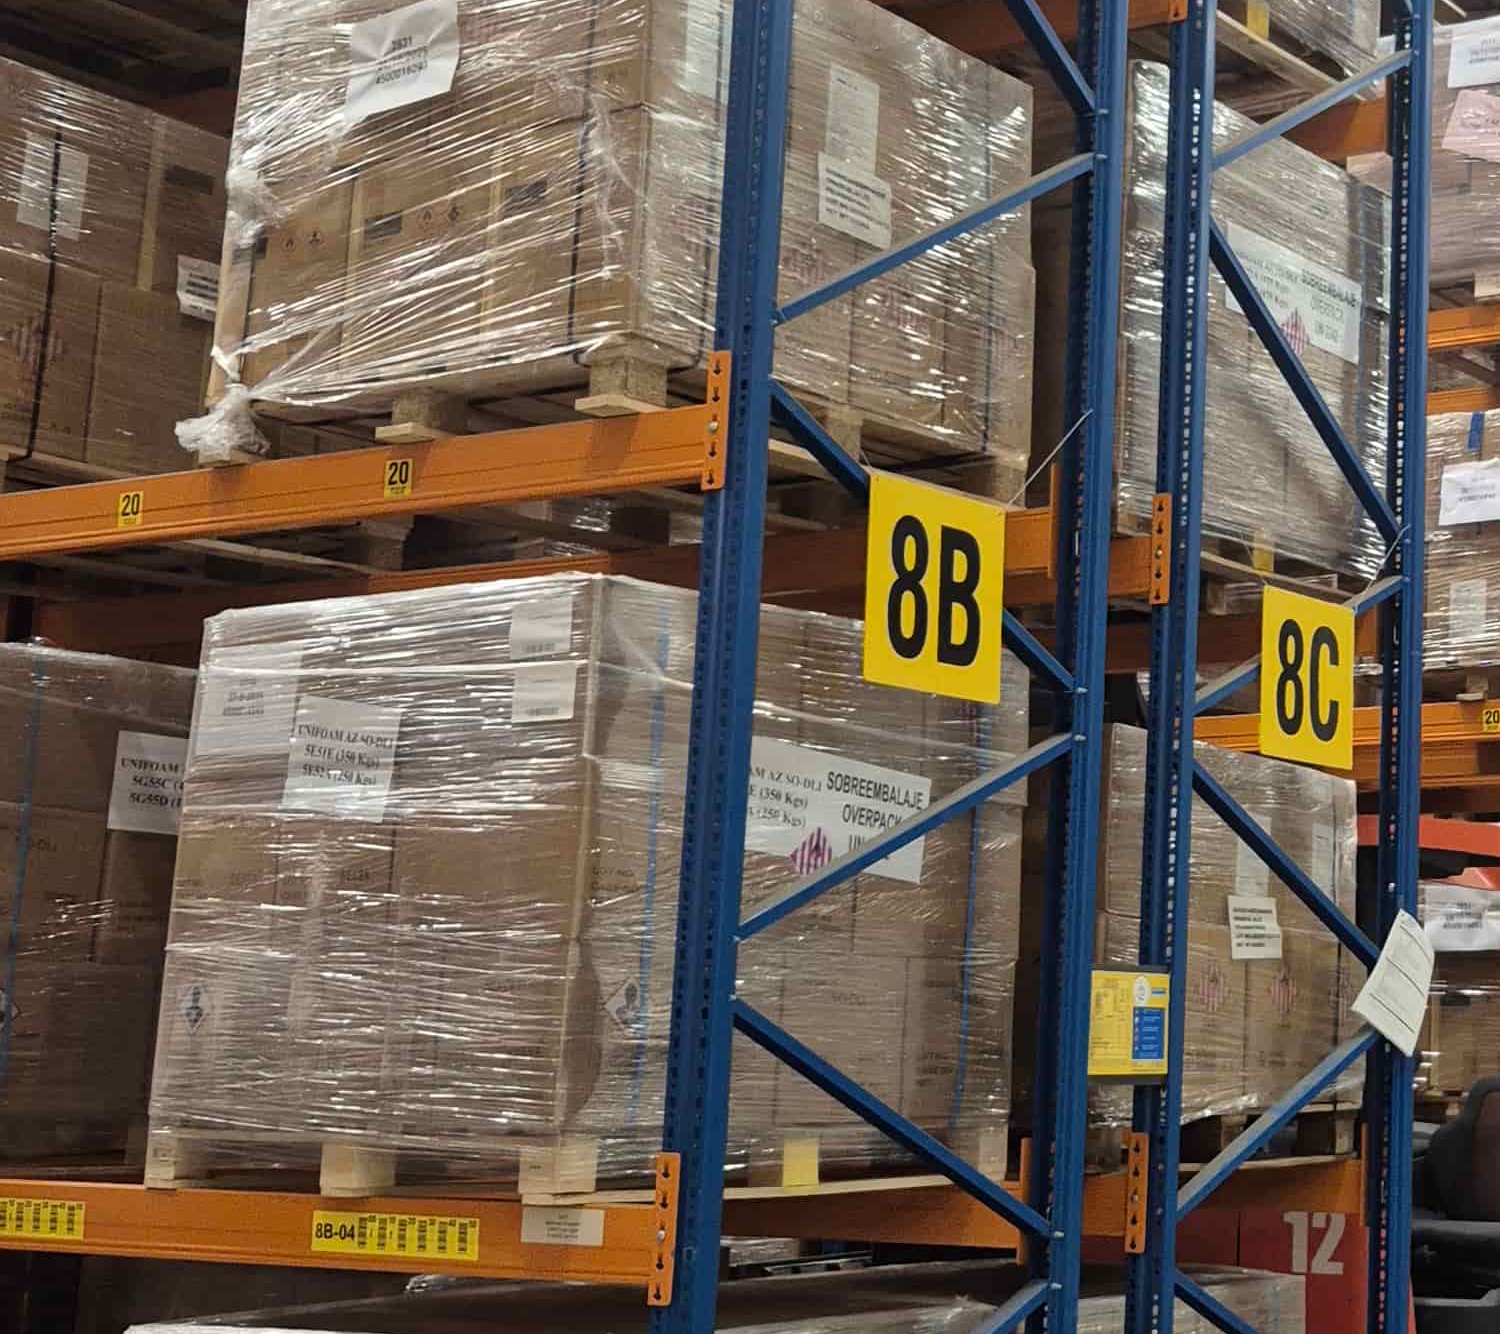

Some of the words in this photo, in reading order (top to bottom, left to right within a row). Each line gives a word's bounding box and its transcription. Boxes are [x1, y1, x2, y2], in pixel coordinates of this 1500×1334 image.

[387, 460, 410, 485] 20
[121, 494, 141, 517] 20
[887, 514, 982, 668] 8B
[1276, 618, 1341, 742] 8C
[1485, 710, 1500, 725] 20
[121, 757, 179, 773] UNIFOAM
[826, 770, 924, 810] SOBREEMBALAJE
[842, 804, 903, 829] OVERPACK
[315, 1222, 356, 1241] 8B-04
[1283, 1211, 1346, 1276] 12
